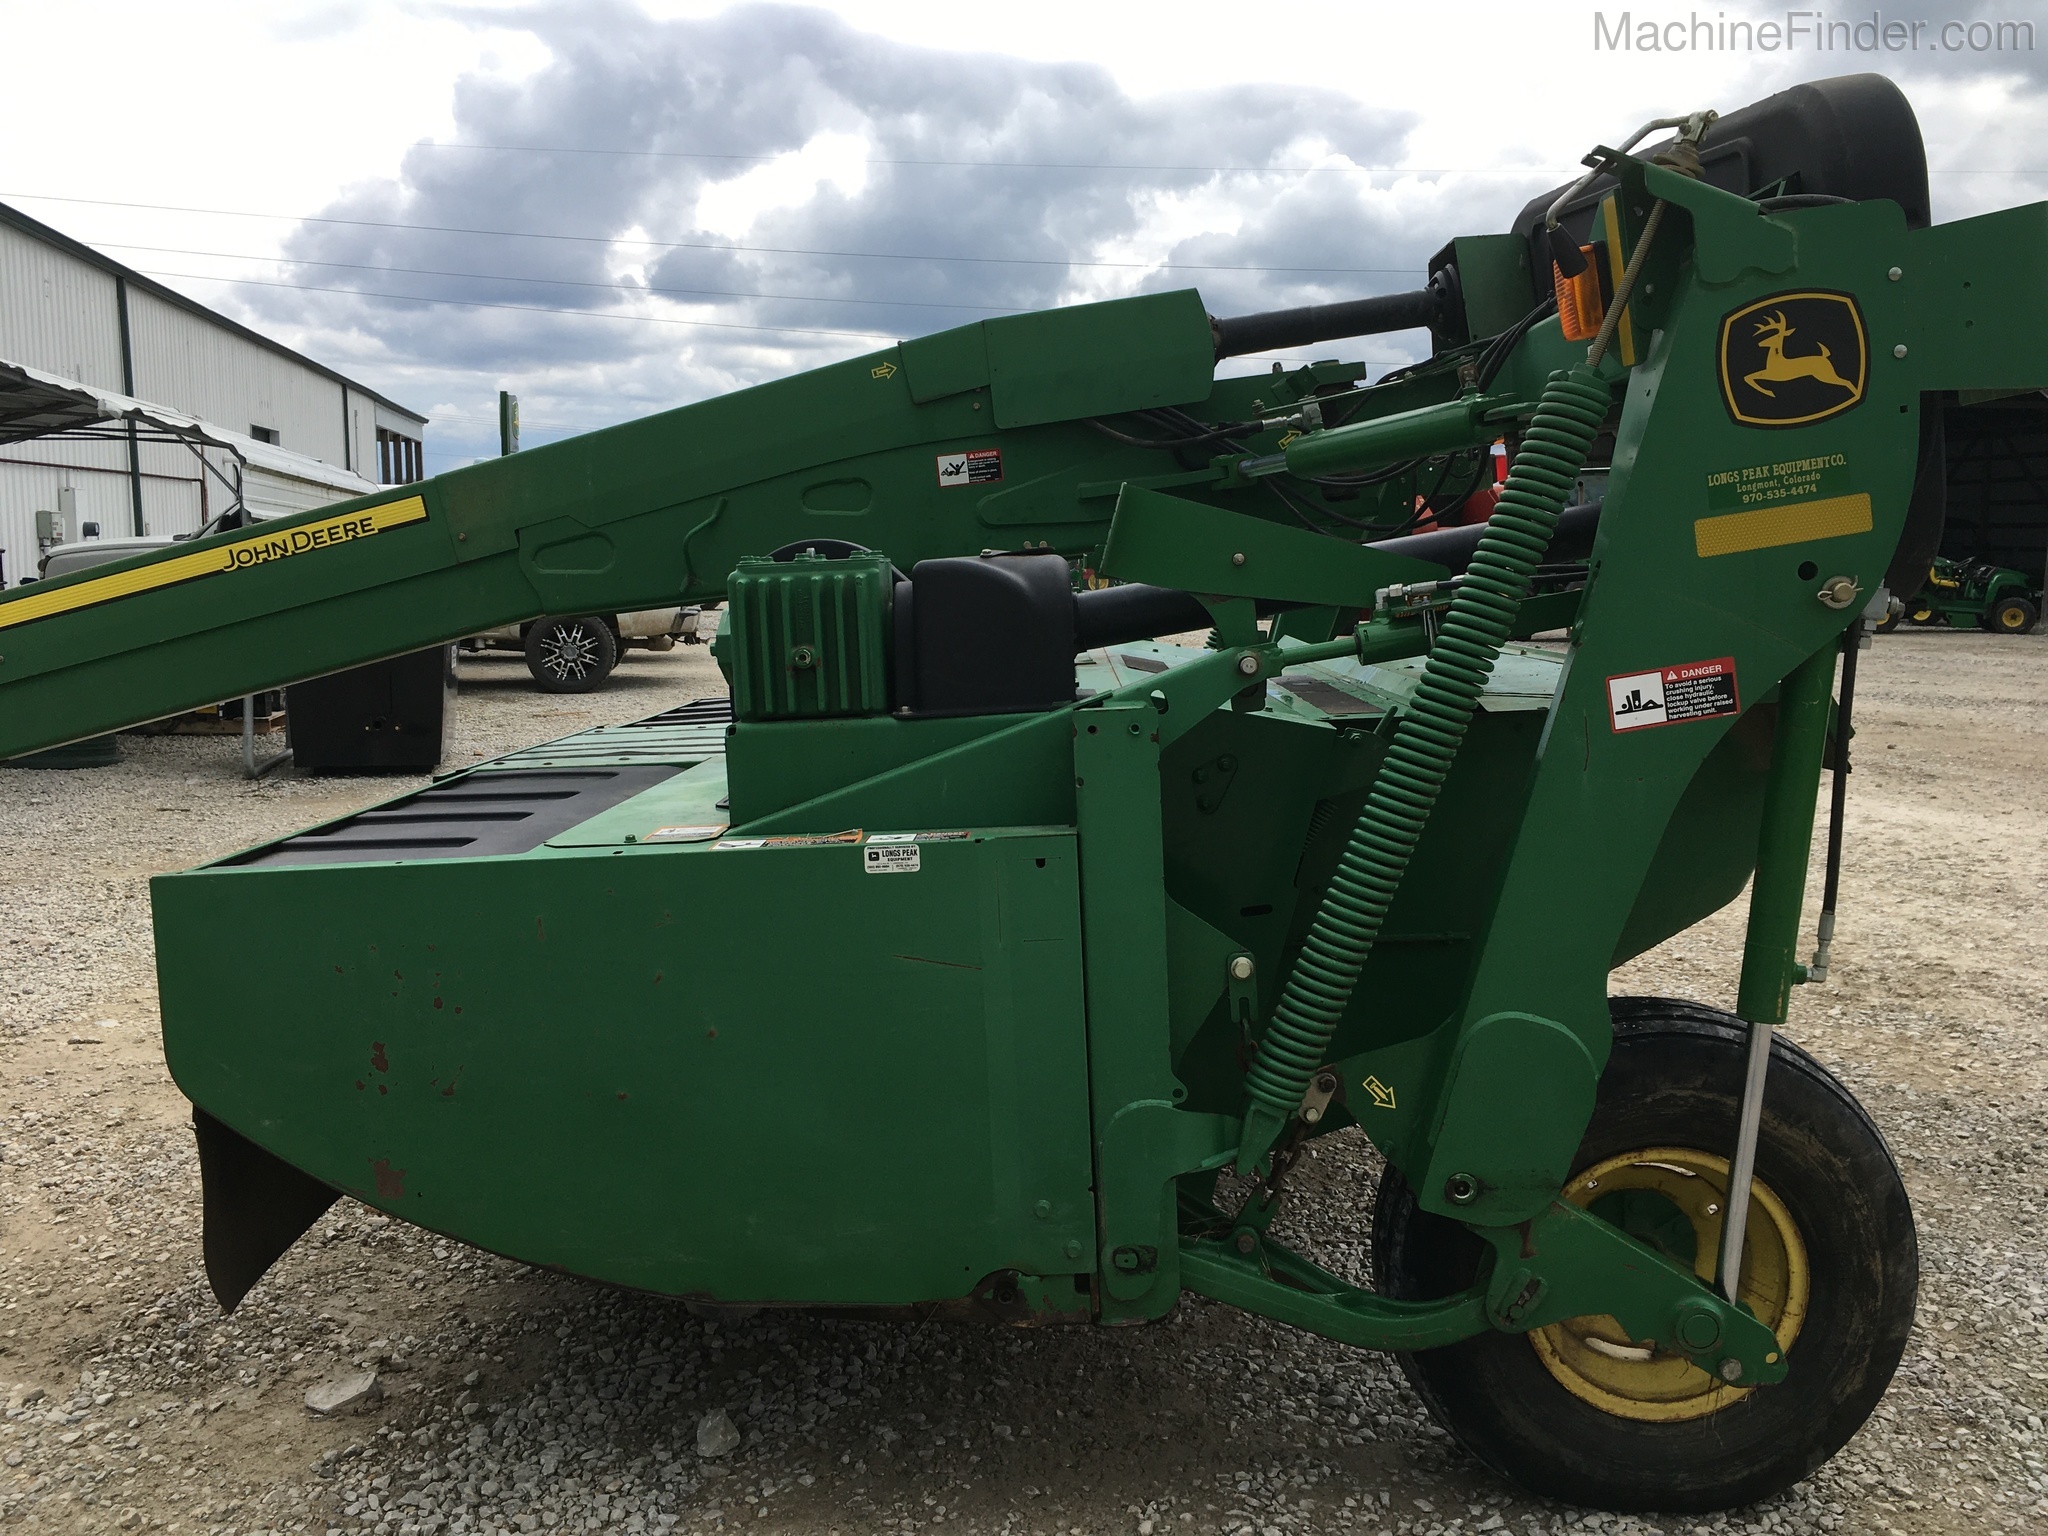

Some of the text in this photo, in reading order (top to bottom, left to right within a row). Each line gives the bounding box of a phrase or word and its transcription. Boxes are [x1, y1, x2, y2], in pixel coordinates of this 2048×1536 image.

[1708, 453, 1847, 487] LONGS PEAK EQUIPMENT CO.
[1737, 471, 1821, 494] Longmont, Colorado
[1743, 483, 1817, 504] 970-535-4474
[223, 517, 376, 570] JOHN DEERE
[1681, 665, 1722, 677] DANGER
[1675, 680, 1692, 688] avoid
[1698, 676, 1722, 684] serious
[1666, 687, 1694, 696] crushing
[1685, 690, 1714, 699] hydraulic
[1668, 710, 1702, 720] harvesting
[882, 848, 918, 857] LONGS PEAK
